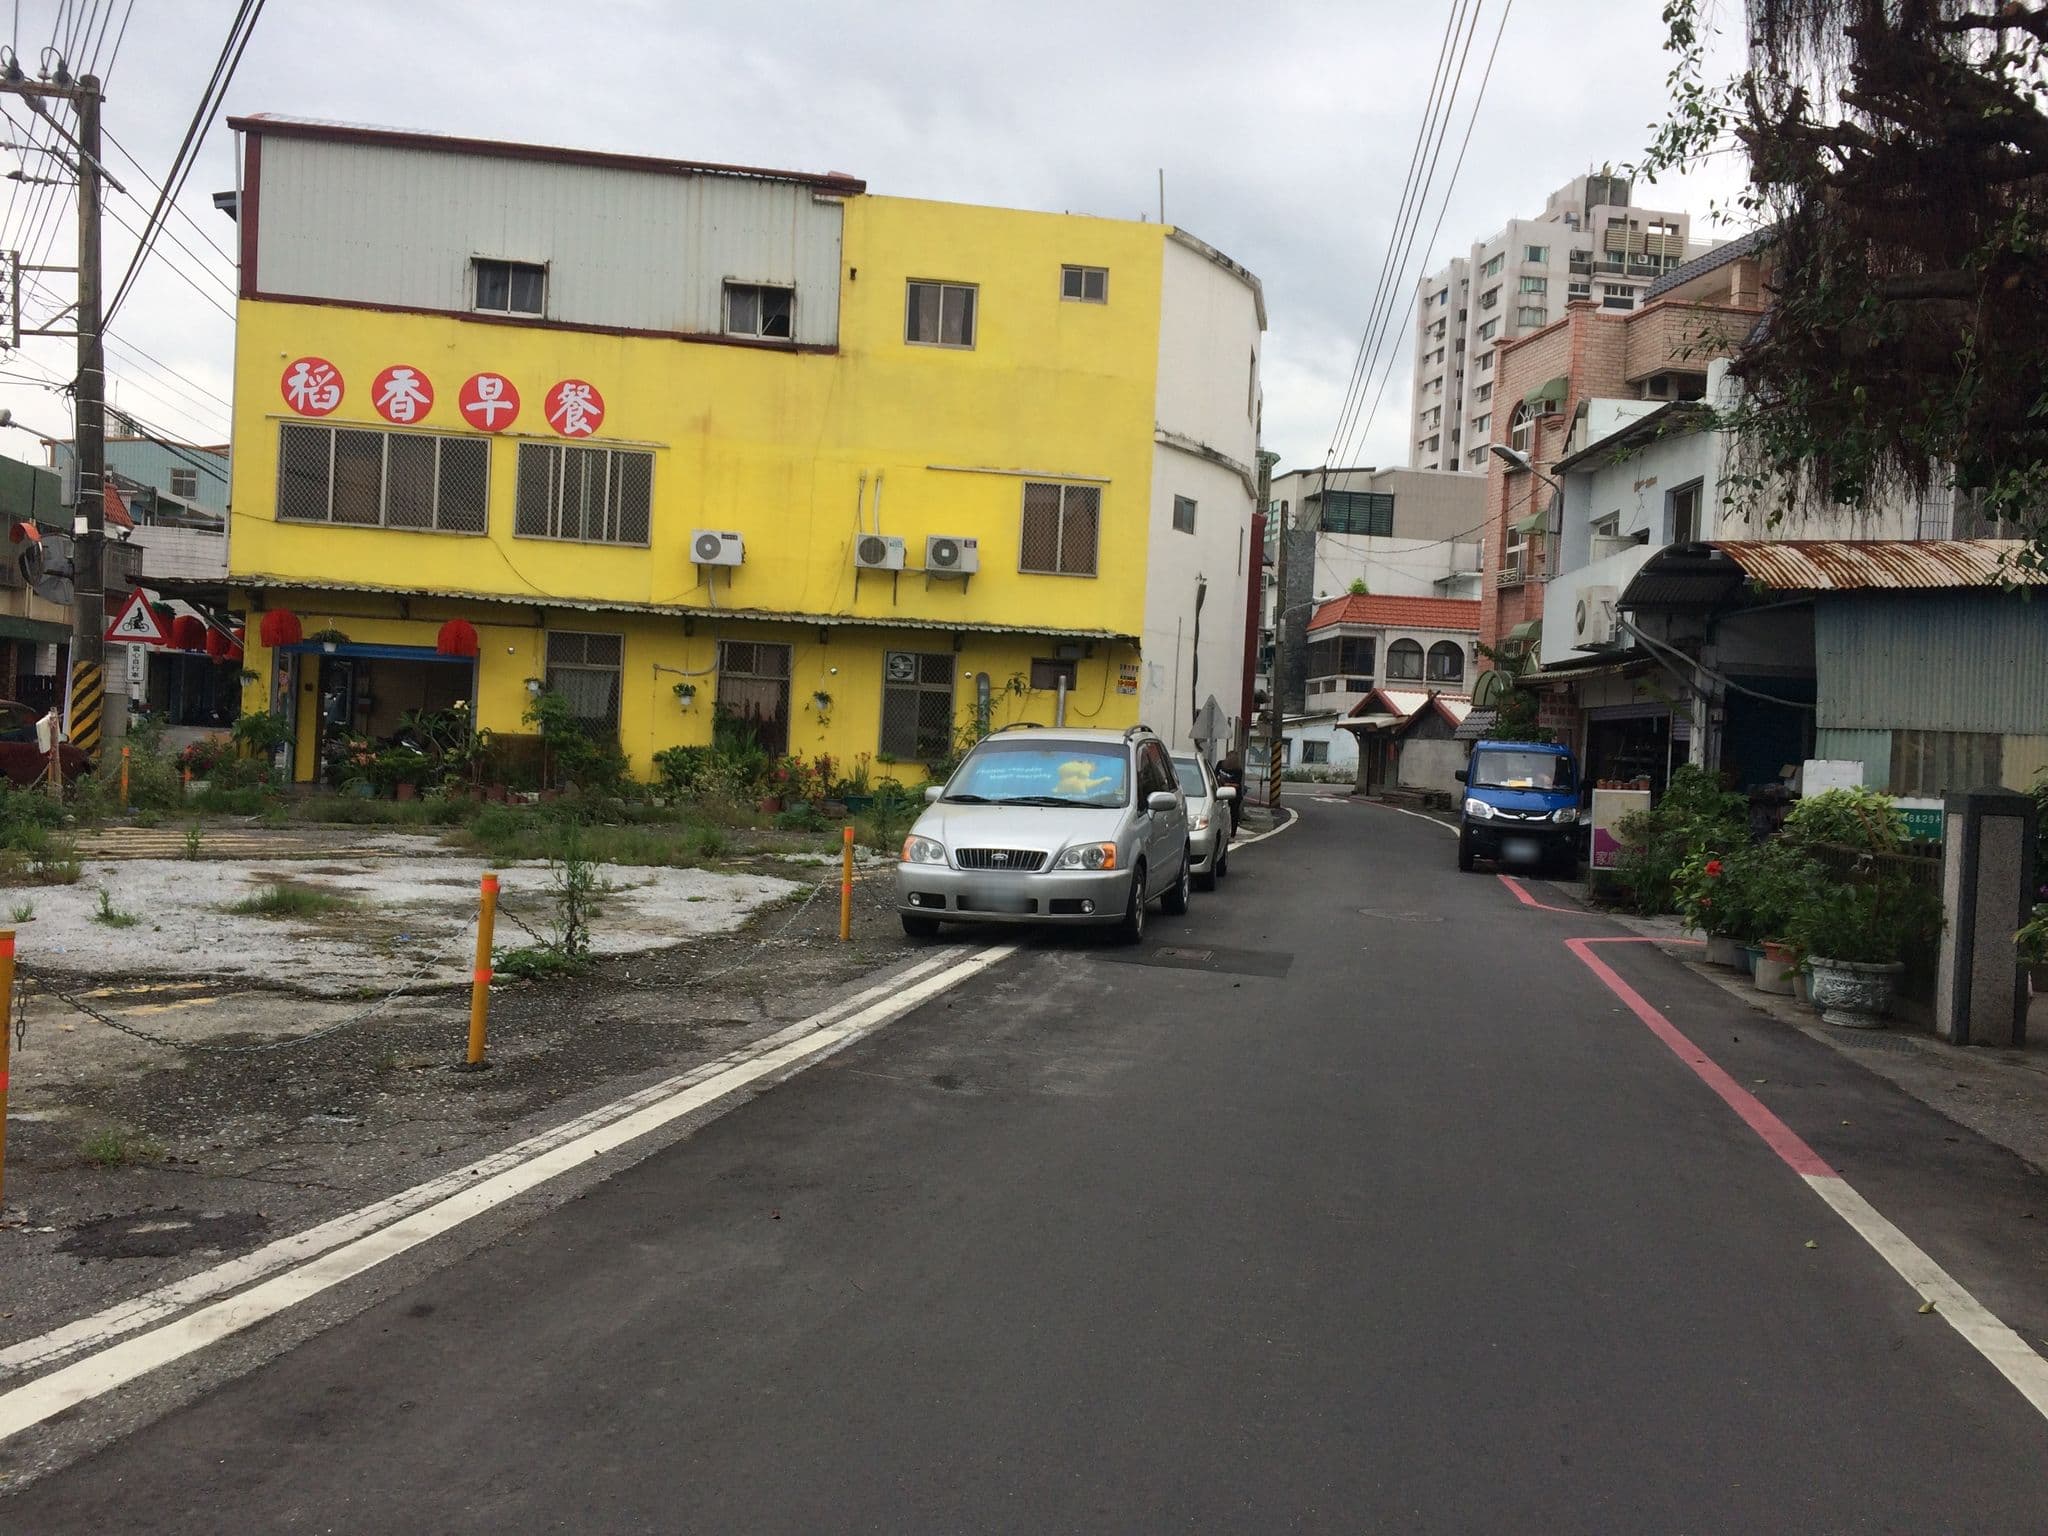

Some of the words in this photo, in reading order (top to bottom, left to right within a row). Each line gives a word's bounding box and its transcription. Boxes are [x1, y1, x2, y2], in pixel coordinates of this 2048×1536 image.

[288, 362, 601, 435] 稻香早餐
[131, 645, 141, 678] 當心自行車
